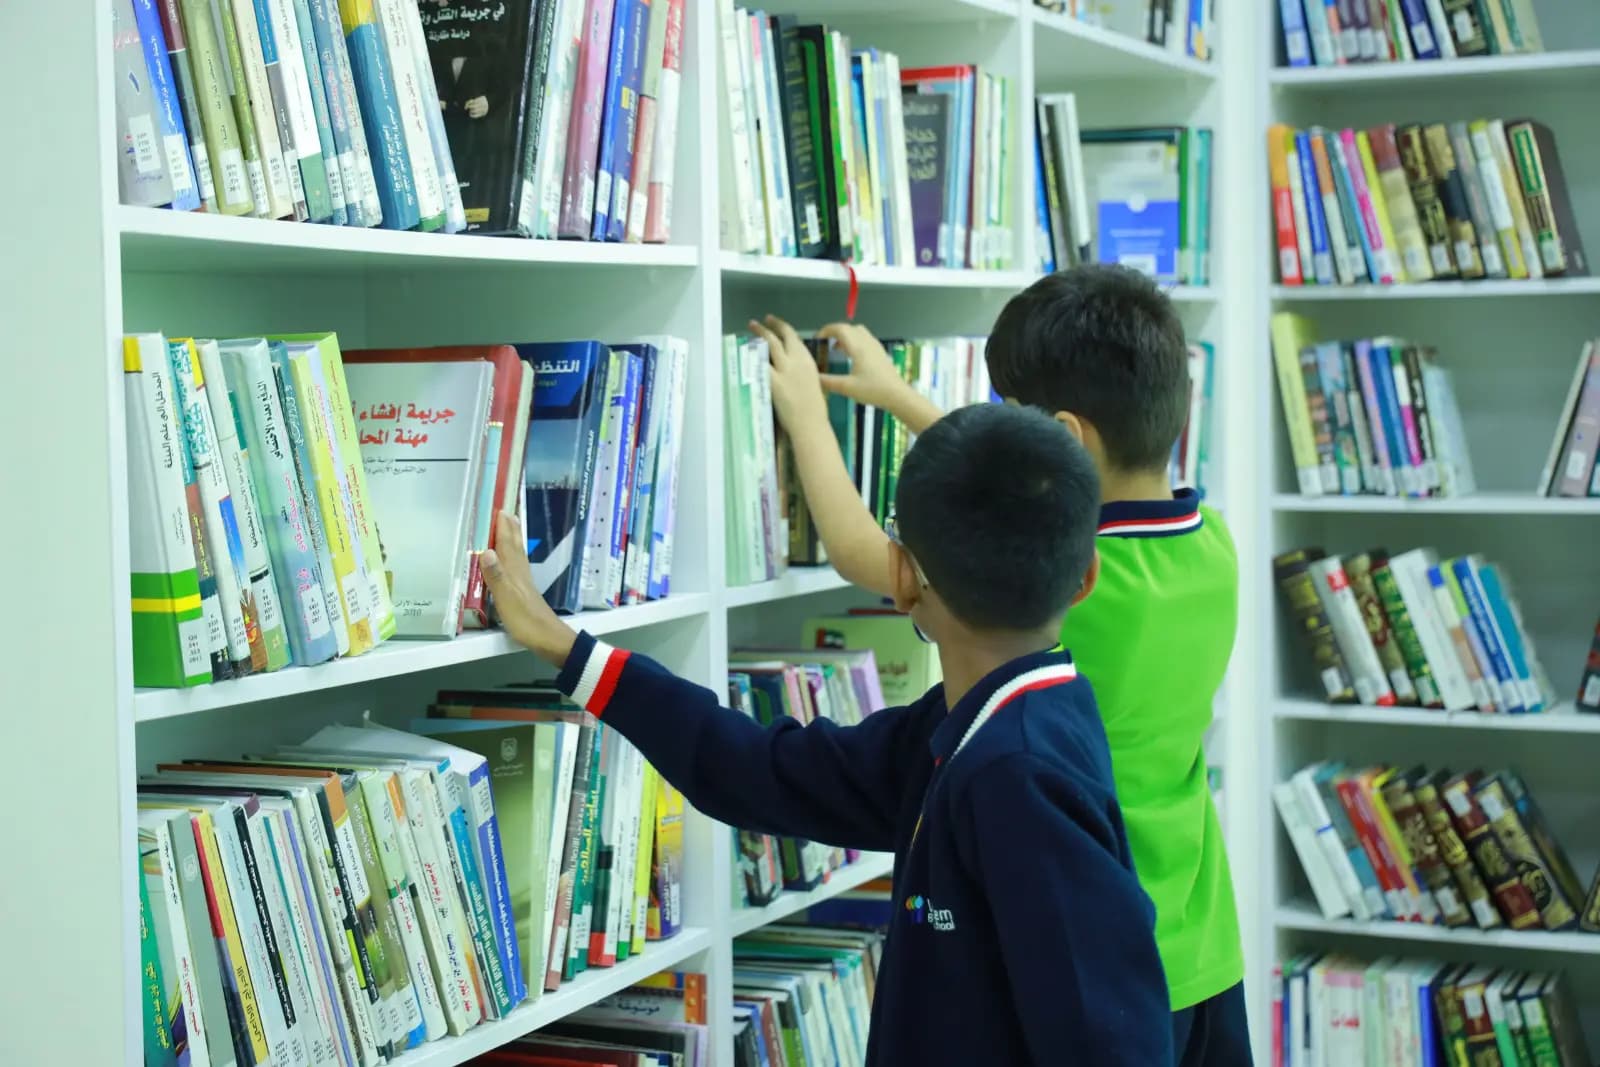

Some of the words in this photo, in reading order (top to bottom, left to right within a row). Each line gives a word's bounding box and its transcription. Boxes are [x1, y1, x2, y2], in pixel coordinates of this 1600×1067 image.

[433, 8, 457, 24] القتل
[460, 6, 490, 21] جريمة
[151, 371, 165, 404] المدخل
[359, 401, 402, 423] إفشاء
[406, 403, 456, 424] جريمة
[394, 428, 429, 448] مهنة
